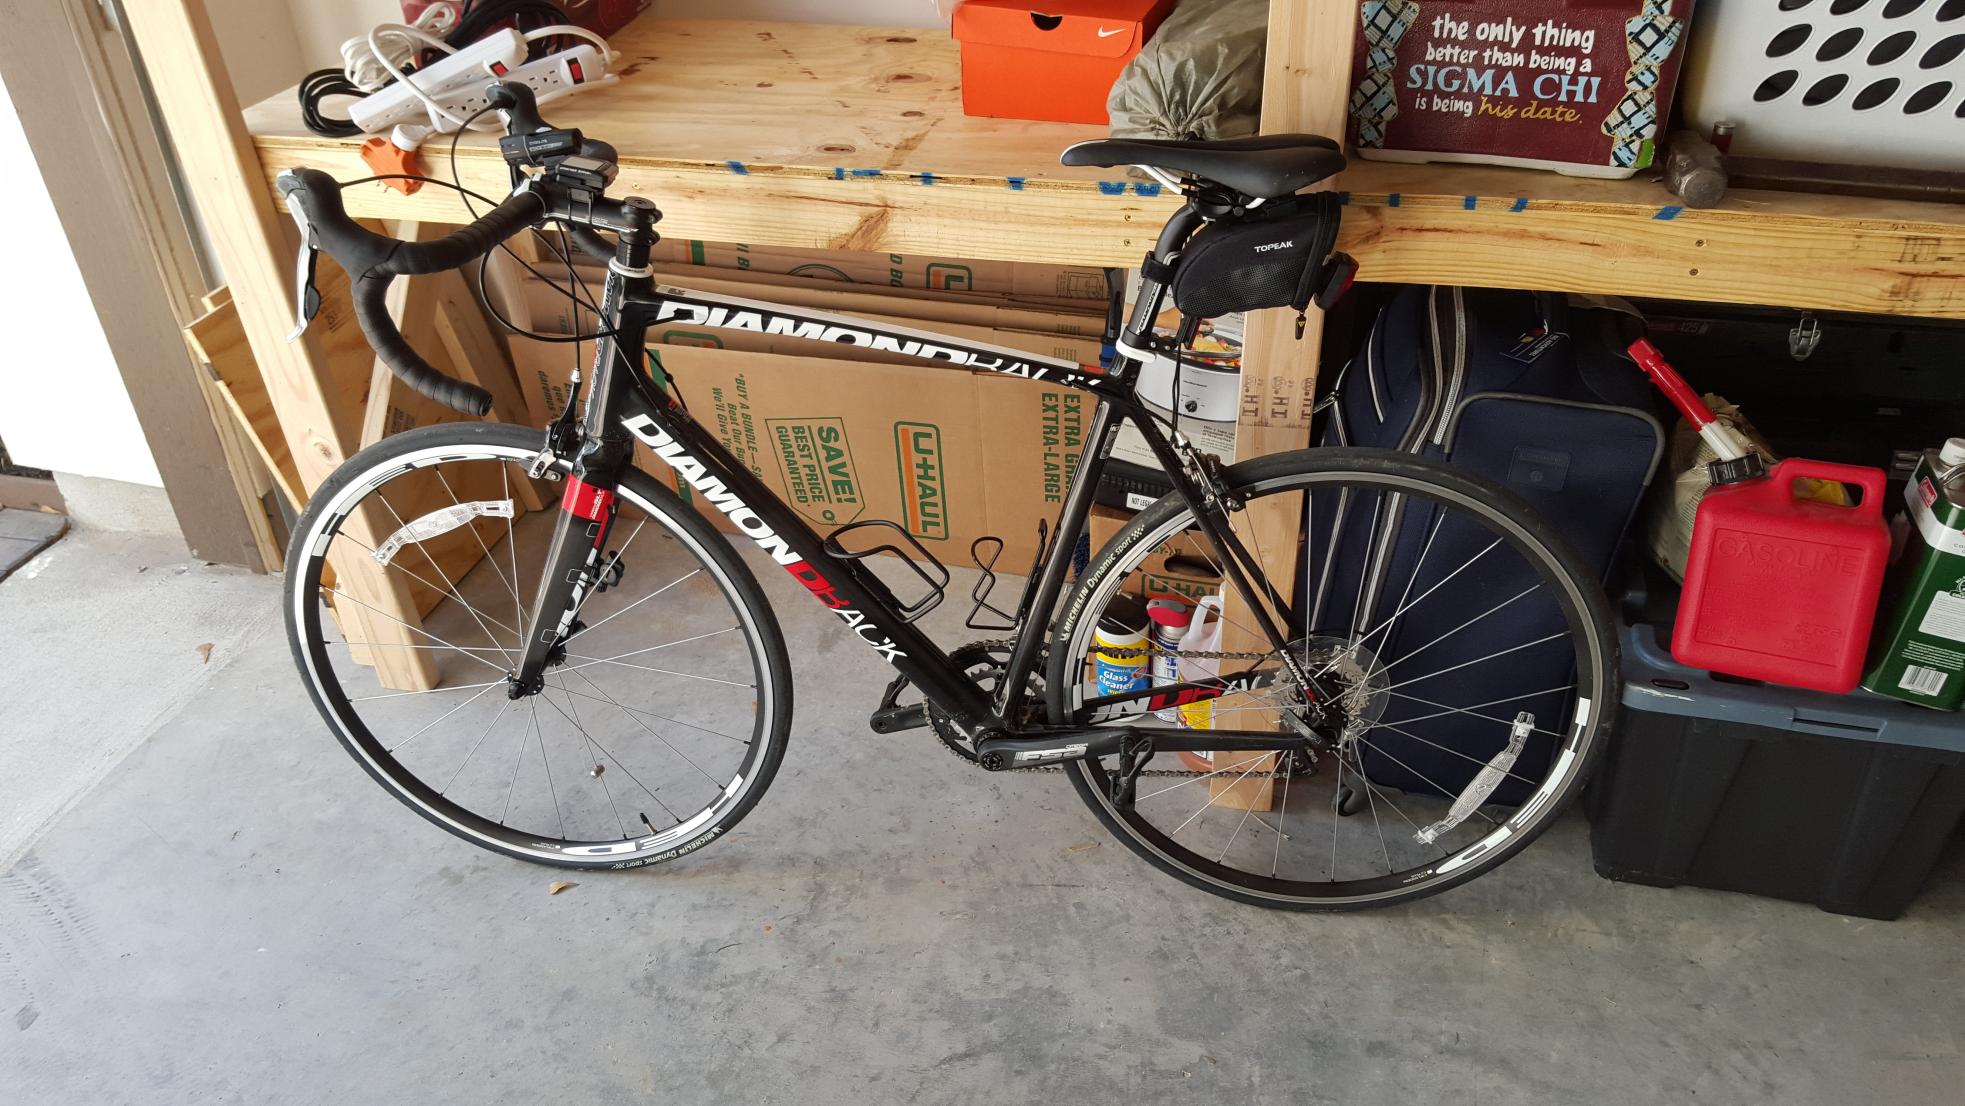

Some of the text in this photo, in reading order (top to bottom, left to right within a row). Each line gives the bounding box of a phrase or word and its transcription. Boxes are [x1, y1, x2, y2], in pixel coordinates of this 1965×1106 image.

[1432, 13, 1595, 54] the only thing
[1425, 42, 1592, 75] better than being a
[1406, 64, 1601, 104] SIGMA CHI
[1415, 94, 1427, 110] is
[1433, 96, 1473, 117] being
[1477, 96, 1517, 119] his
[1253, 239, 1294, 254] TOPEAK
[716, 413, 729, 434] Give
[726, 403, 739, 426] Beat
[1063, 394, 1081, 446] EXTRA
[731, 428, 742, 444] Our
[1041, 393, 1061, 503] EXTRA-LARGE
[791, 425, 825, 503] BEST PRICE
[816, 425, 857, 505] SAVE!
[914, 431, 941, 533] U-HAUL
[620, 413, 908, 664] DIAMONDBACK
[1718, 537, 1860, 576] GASOLINE
[1065, 536, 1132, 635] MICHELIN Dynamic sport
[1099, 675, 1135, 690] Cleaner
[1103, 671, 1128, 682] Glass
[645, 849, 677, 865] Dynamic
[679, 832, 715, 855] MICHELIN
